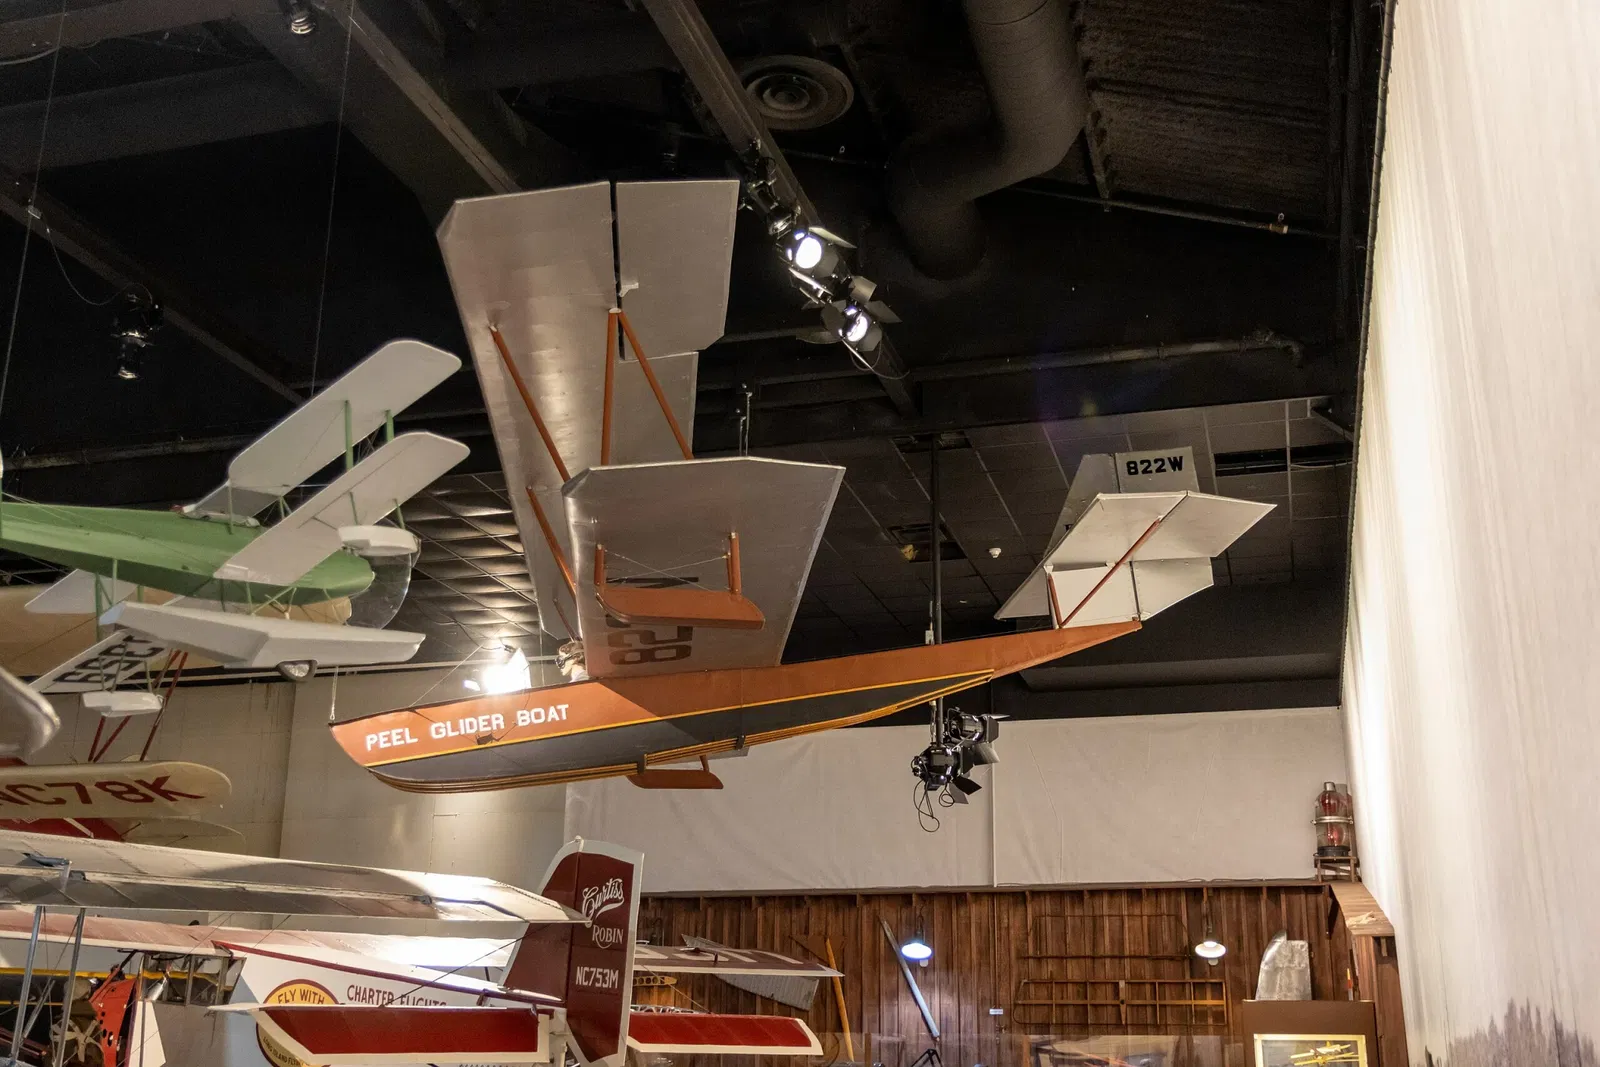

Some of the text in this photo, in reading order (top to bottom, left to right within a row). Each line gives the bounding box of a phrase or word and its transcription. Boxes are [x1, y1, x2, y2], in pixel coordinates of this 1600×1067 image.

[1126, 456, 1183, 475] 822W
[366, 704, 569, 752] PEEL GLIDER BOAT
[582, 877, 625, 920] Curtiss
[592, 925, 624, 949] ROBIN
[576, 966, 619, 989] NC753M
[278, 988, 325, 1005] FLY WITH
[347, 984, 395, 1006] CHARTER
